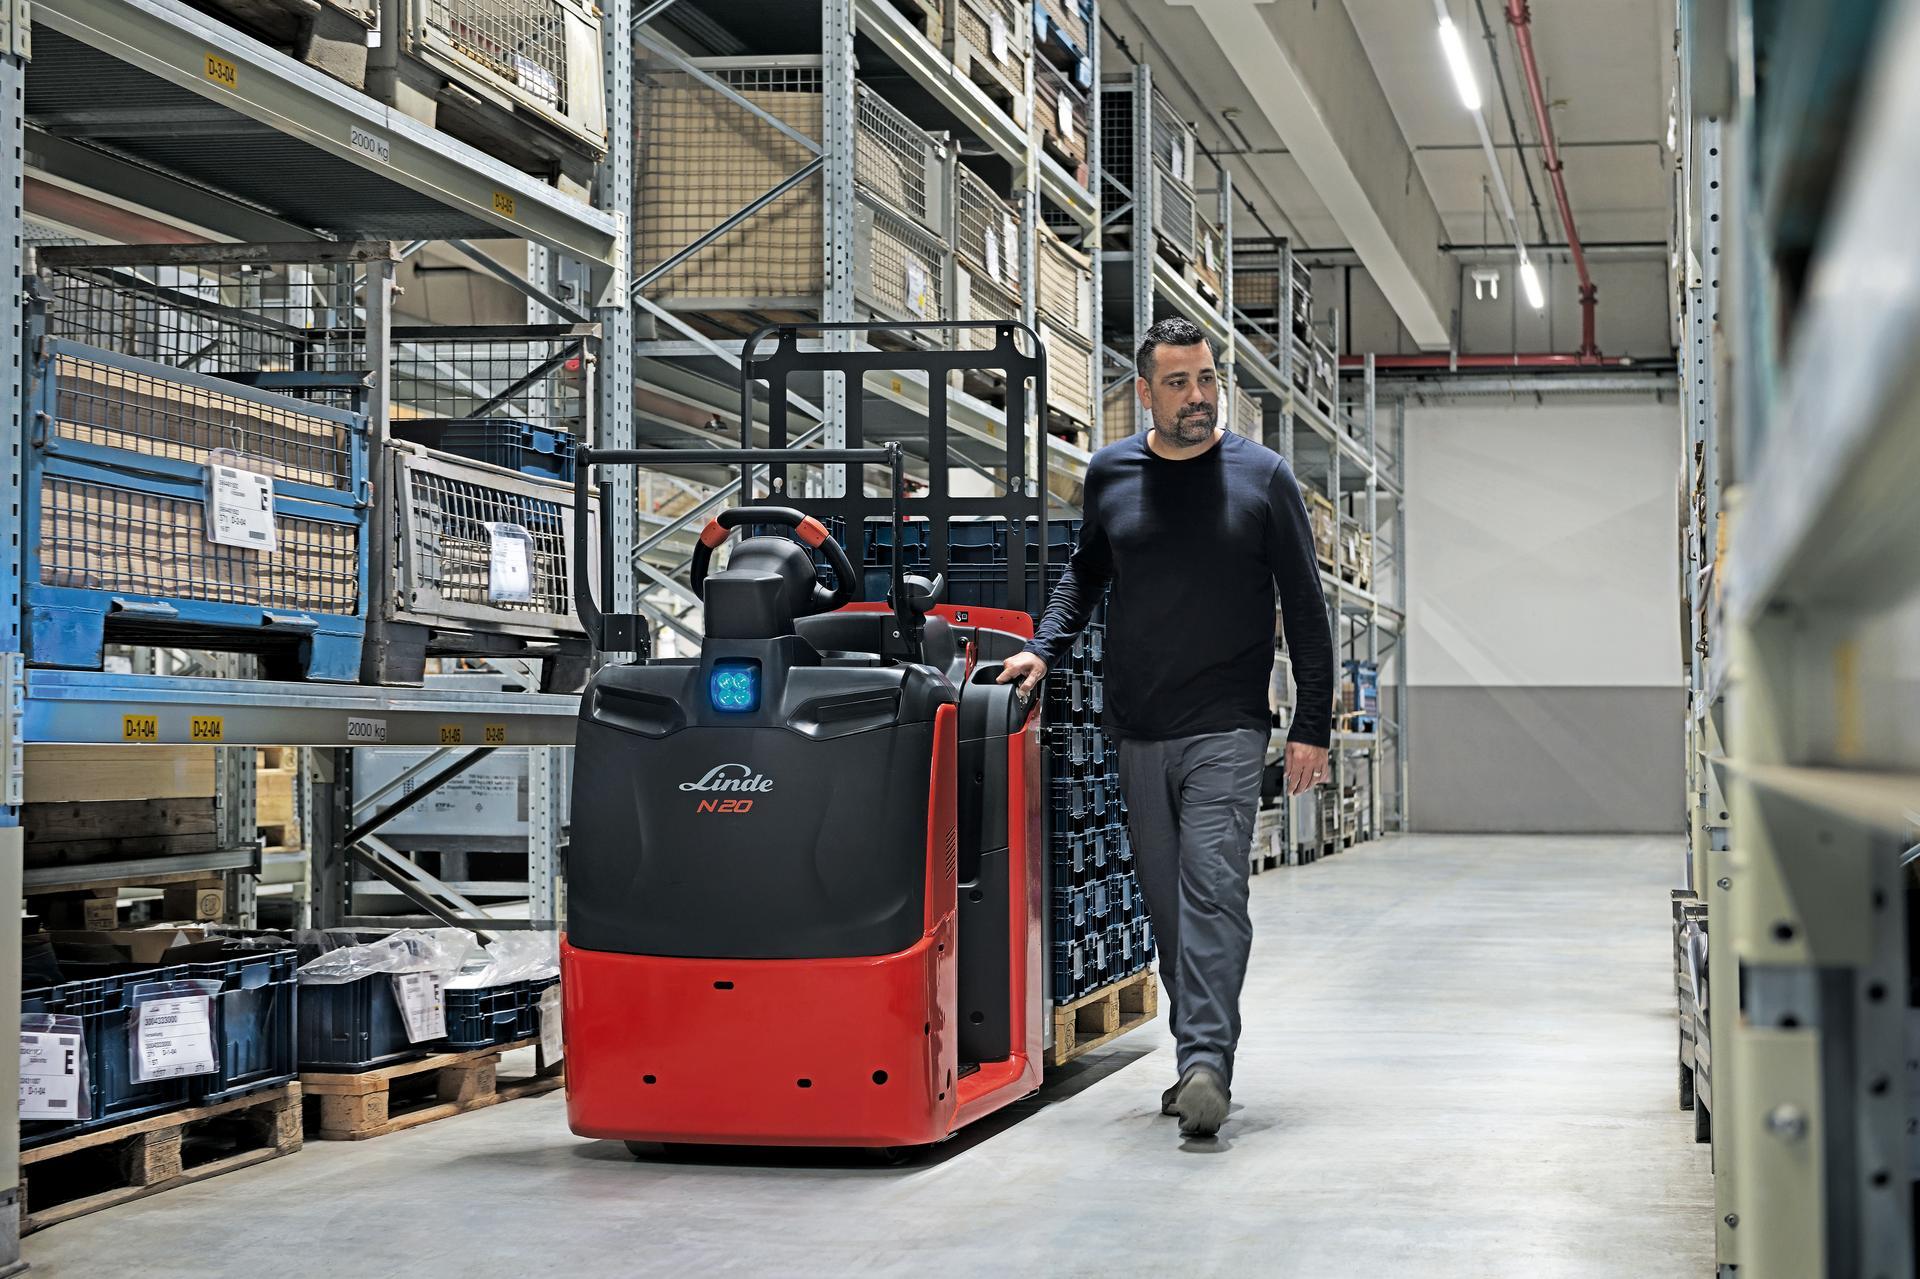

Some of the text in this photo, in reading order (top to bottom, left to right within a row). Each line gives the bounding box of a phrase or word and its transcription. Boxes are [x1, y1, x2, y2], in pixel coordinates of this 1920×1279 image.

[208, 58, 234, 84] D-3-04
[351, 130, 389, 162] 2000 kg
[260, 487, 269, 511] E
[126, 719, 155, 738] D-1-04
[194, 720, 221, 737] D-2-04
[348, 722, 387, 741] 2000 kg
[441, 728, 461, 742] D-1-05
[486, 727, 505, 741] D-2-05
[679, 763, 773, 793] Linde
[65, 1048, 75, 1075] E
